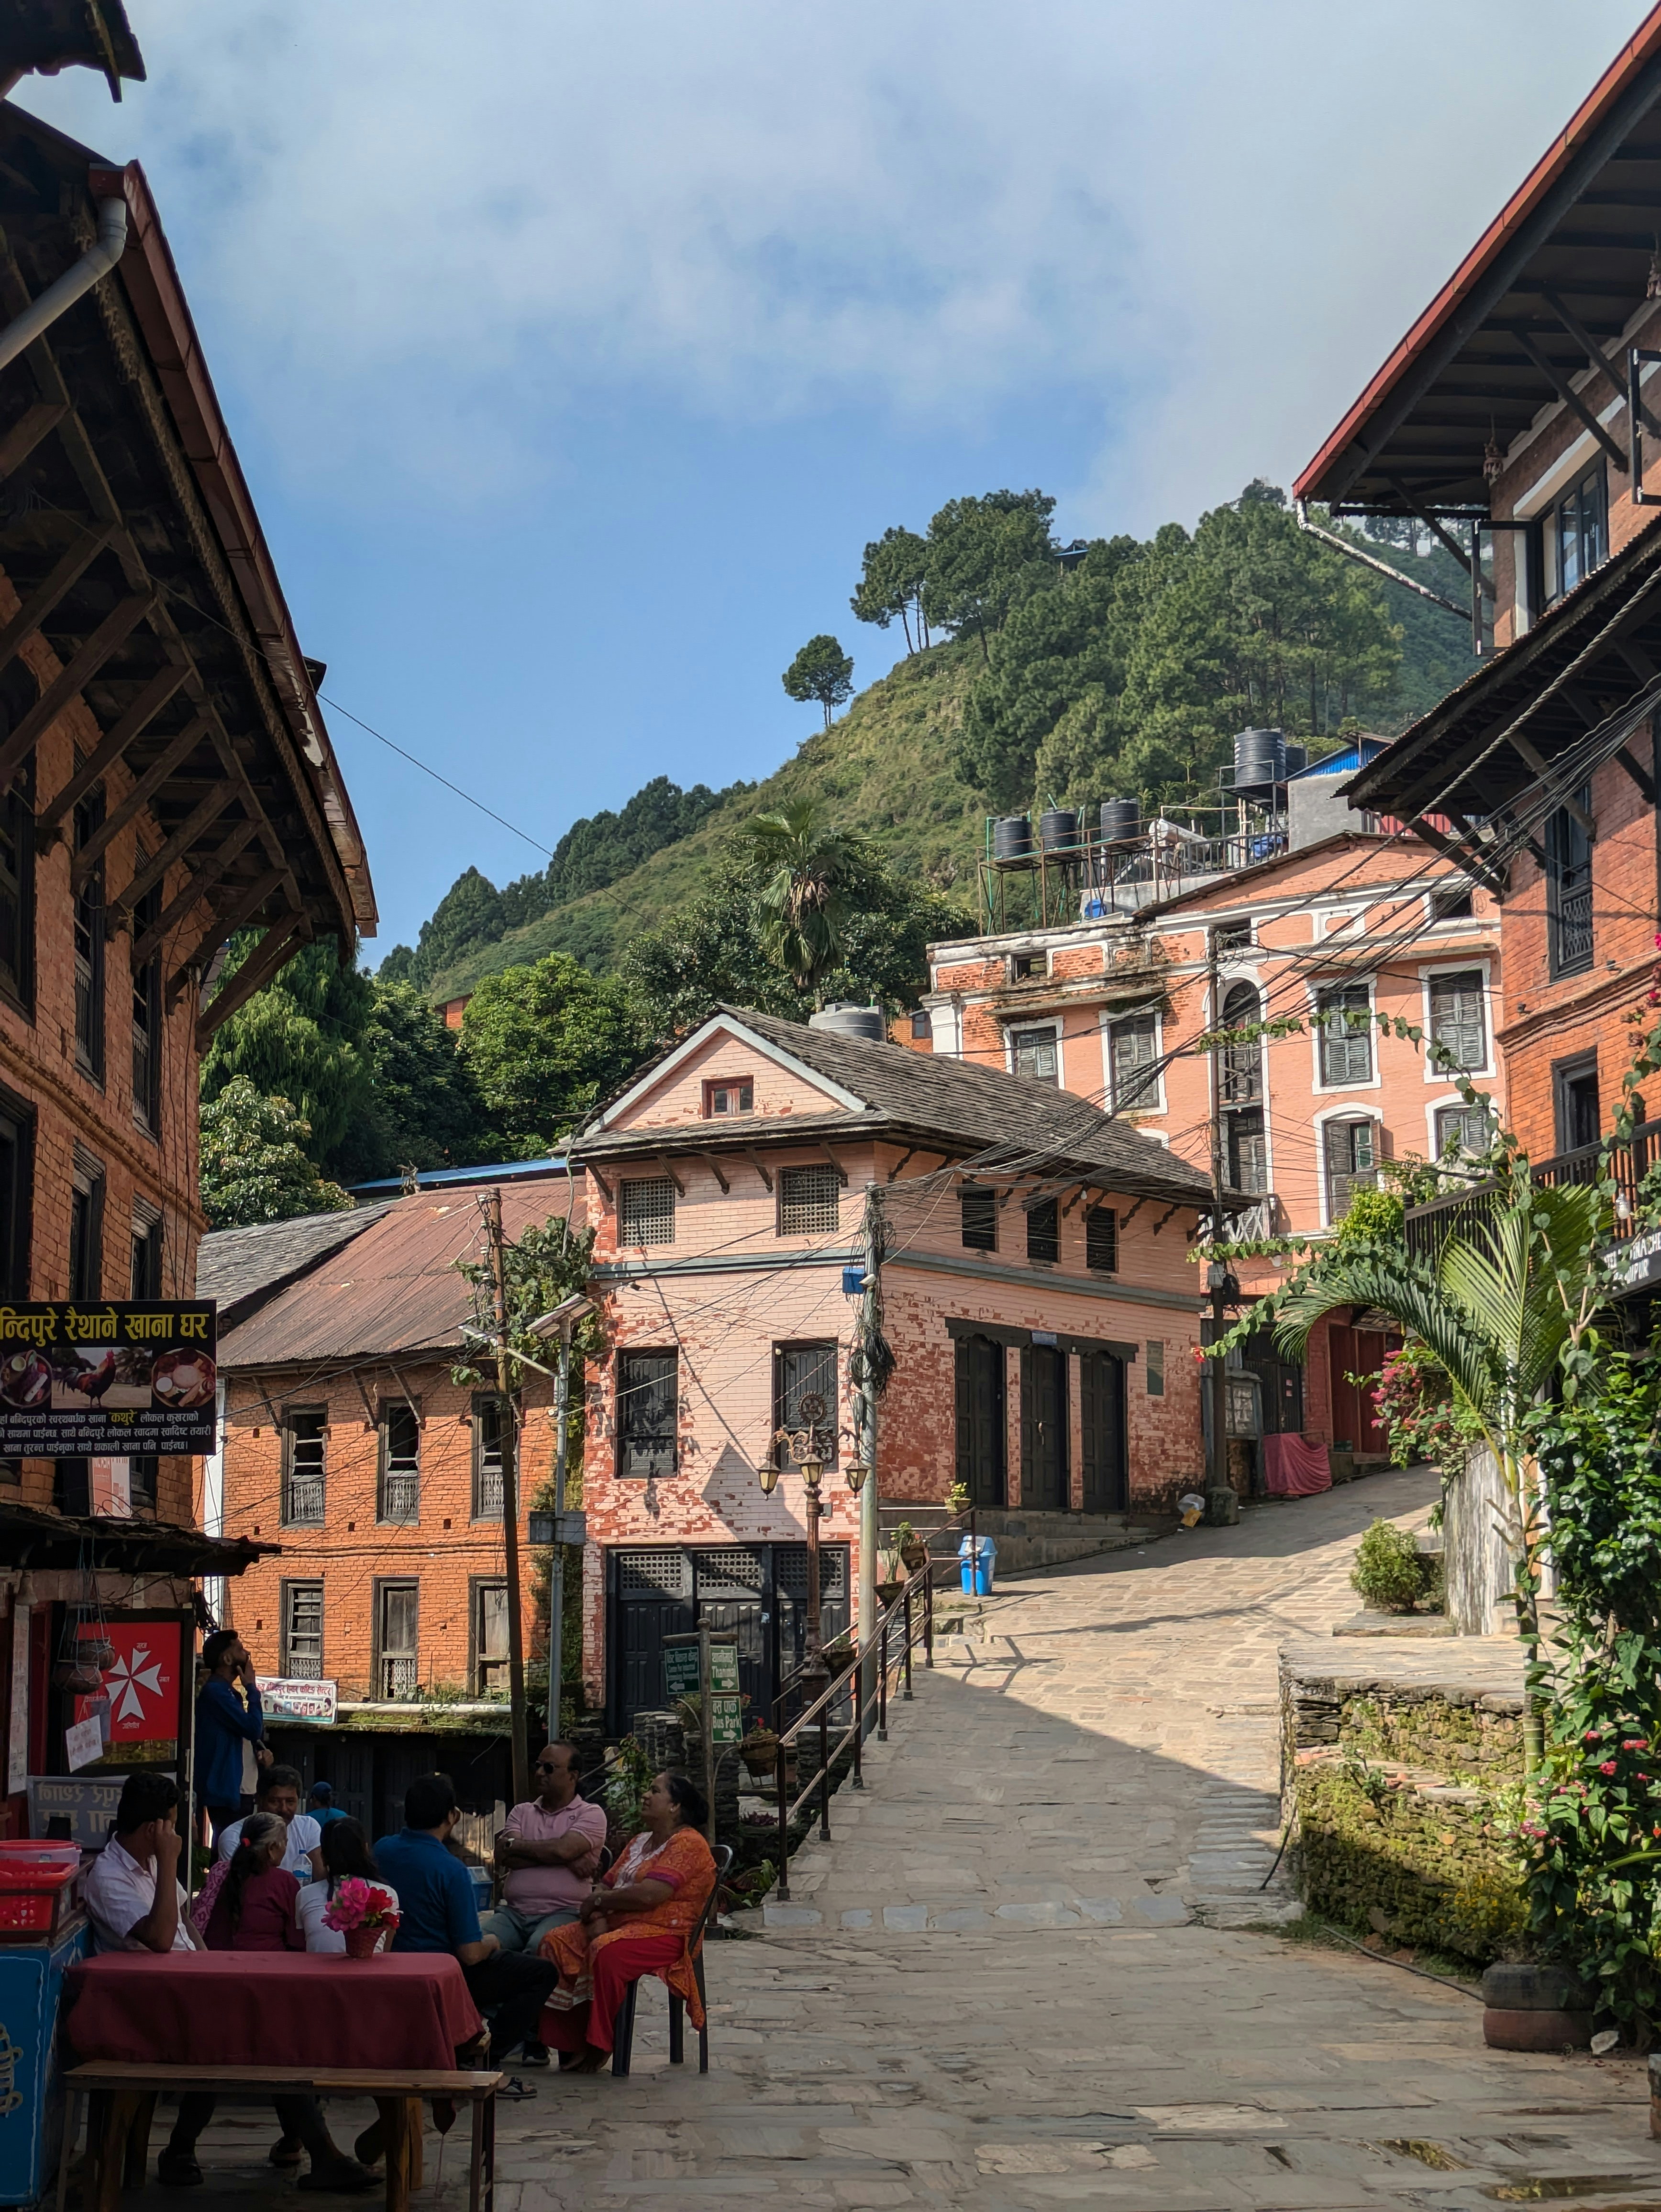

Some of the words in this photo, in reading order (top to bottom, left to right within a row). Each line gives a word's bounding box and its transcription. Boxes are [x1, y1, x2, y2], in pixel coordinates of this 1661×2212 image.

[0, 1306, 59, 1347] न्दिपुरे
[65, 1306, 119, 1340] रैथाने
[124, 1314, 174, 1339] खाना
[180, 1314, 210, 1338] घर
[88, 1415, 106, 1424] खाना
[140, 1411, 164, 1423] लोकल
[166, 1410, 199, 1424] कुखराको
[107, 1426, 132, 1437] लोकल
[190, 1425, 211, 1436] तयारी
[3, 1443, 22, 1453] खाना
[122, 1442, 141, 1451] खाना
[143, 1439, 156, 1450] पनि
[712, 1715, 724, 1729] Bus
[725, 1714, 741, 1729] Park
